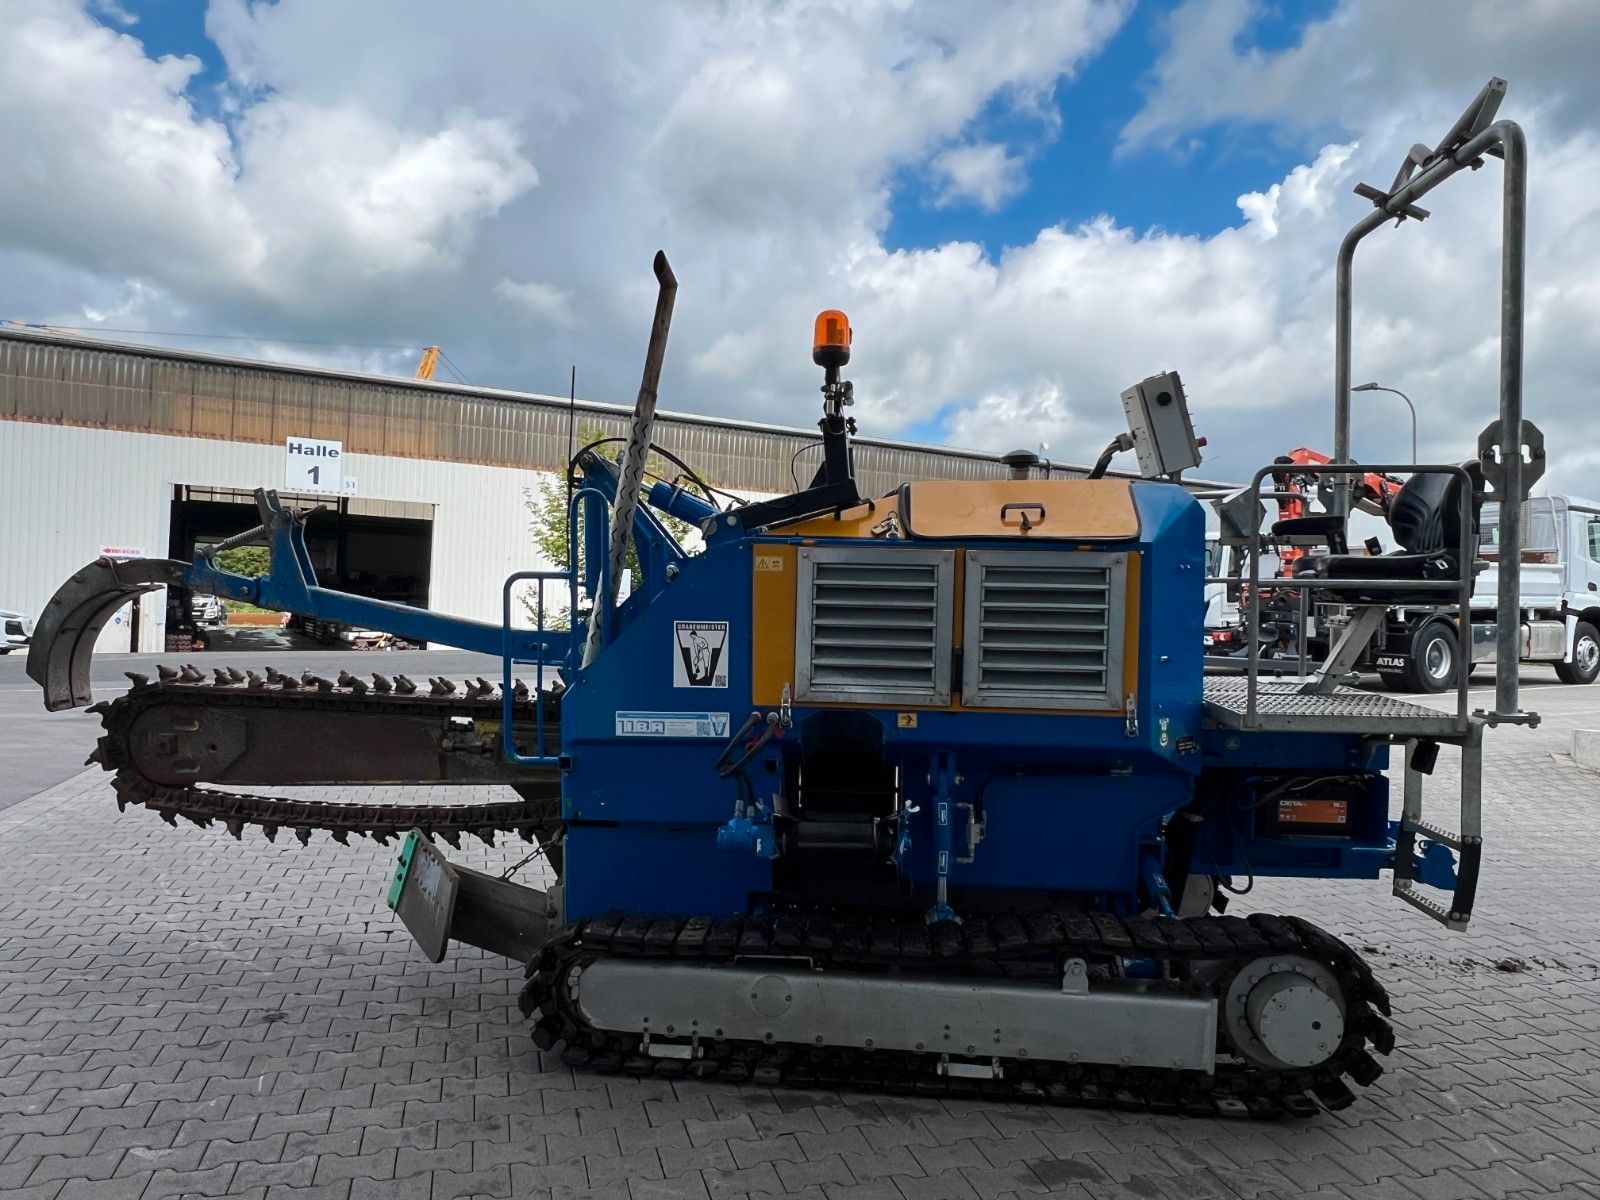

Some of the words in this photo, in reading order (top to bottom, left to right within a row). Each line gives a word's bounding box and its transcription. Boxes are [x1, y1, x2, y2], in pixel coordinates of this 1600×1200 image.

[288, 442, 340, 458] Halle
[307, 465, 320, 485] 1
[1376, 657, 1405, 667] ATLAS
